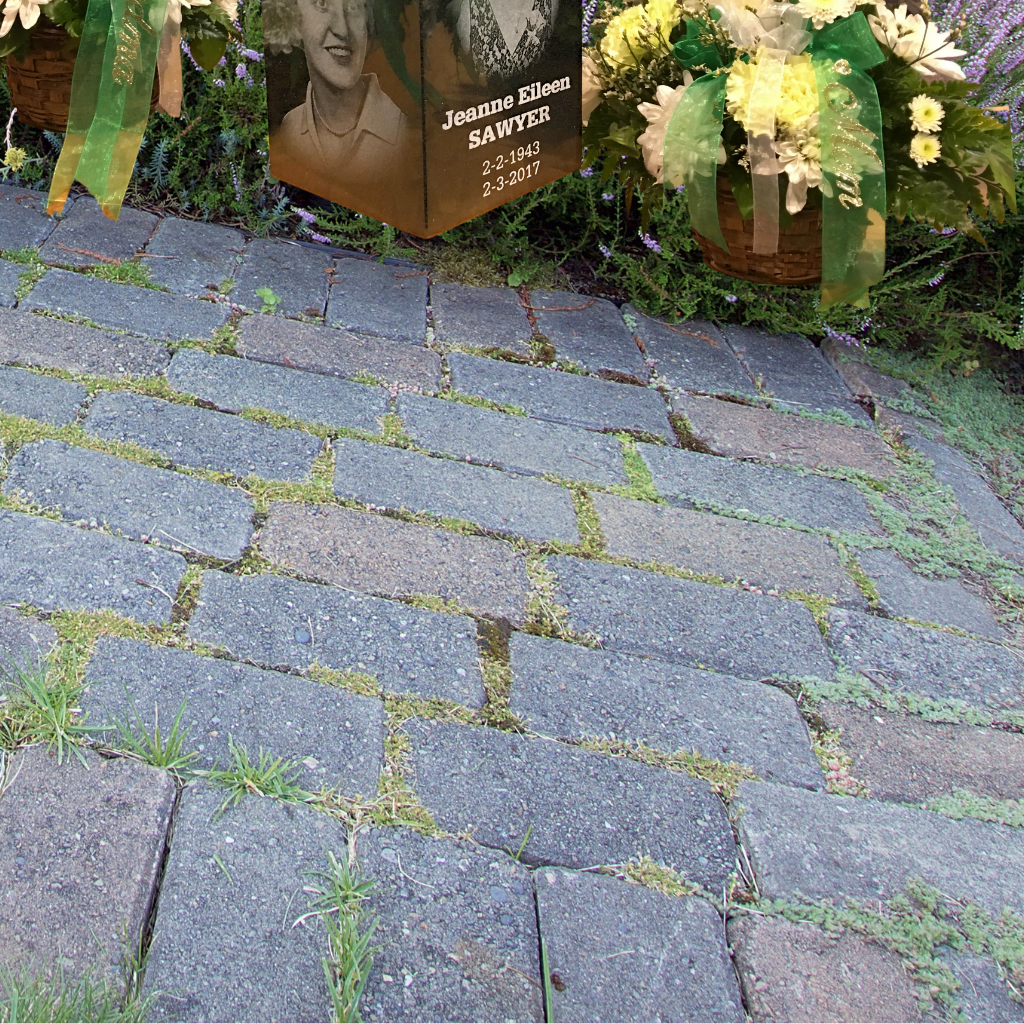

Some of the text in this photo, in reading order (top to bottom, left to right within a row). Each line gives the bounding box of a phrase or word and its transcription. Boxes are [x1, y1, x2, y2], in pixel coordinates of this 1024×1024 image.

[441, 76, 571, 131] Jeanne Eileen
[468, 105, 551, 150] SAWYER
[823, 82, 883, 209] Mom
[482, 140, 540, 176] 2-2-1943
[482, 160, 541, 198] 2-3-2017
